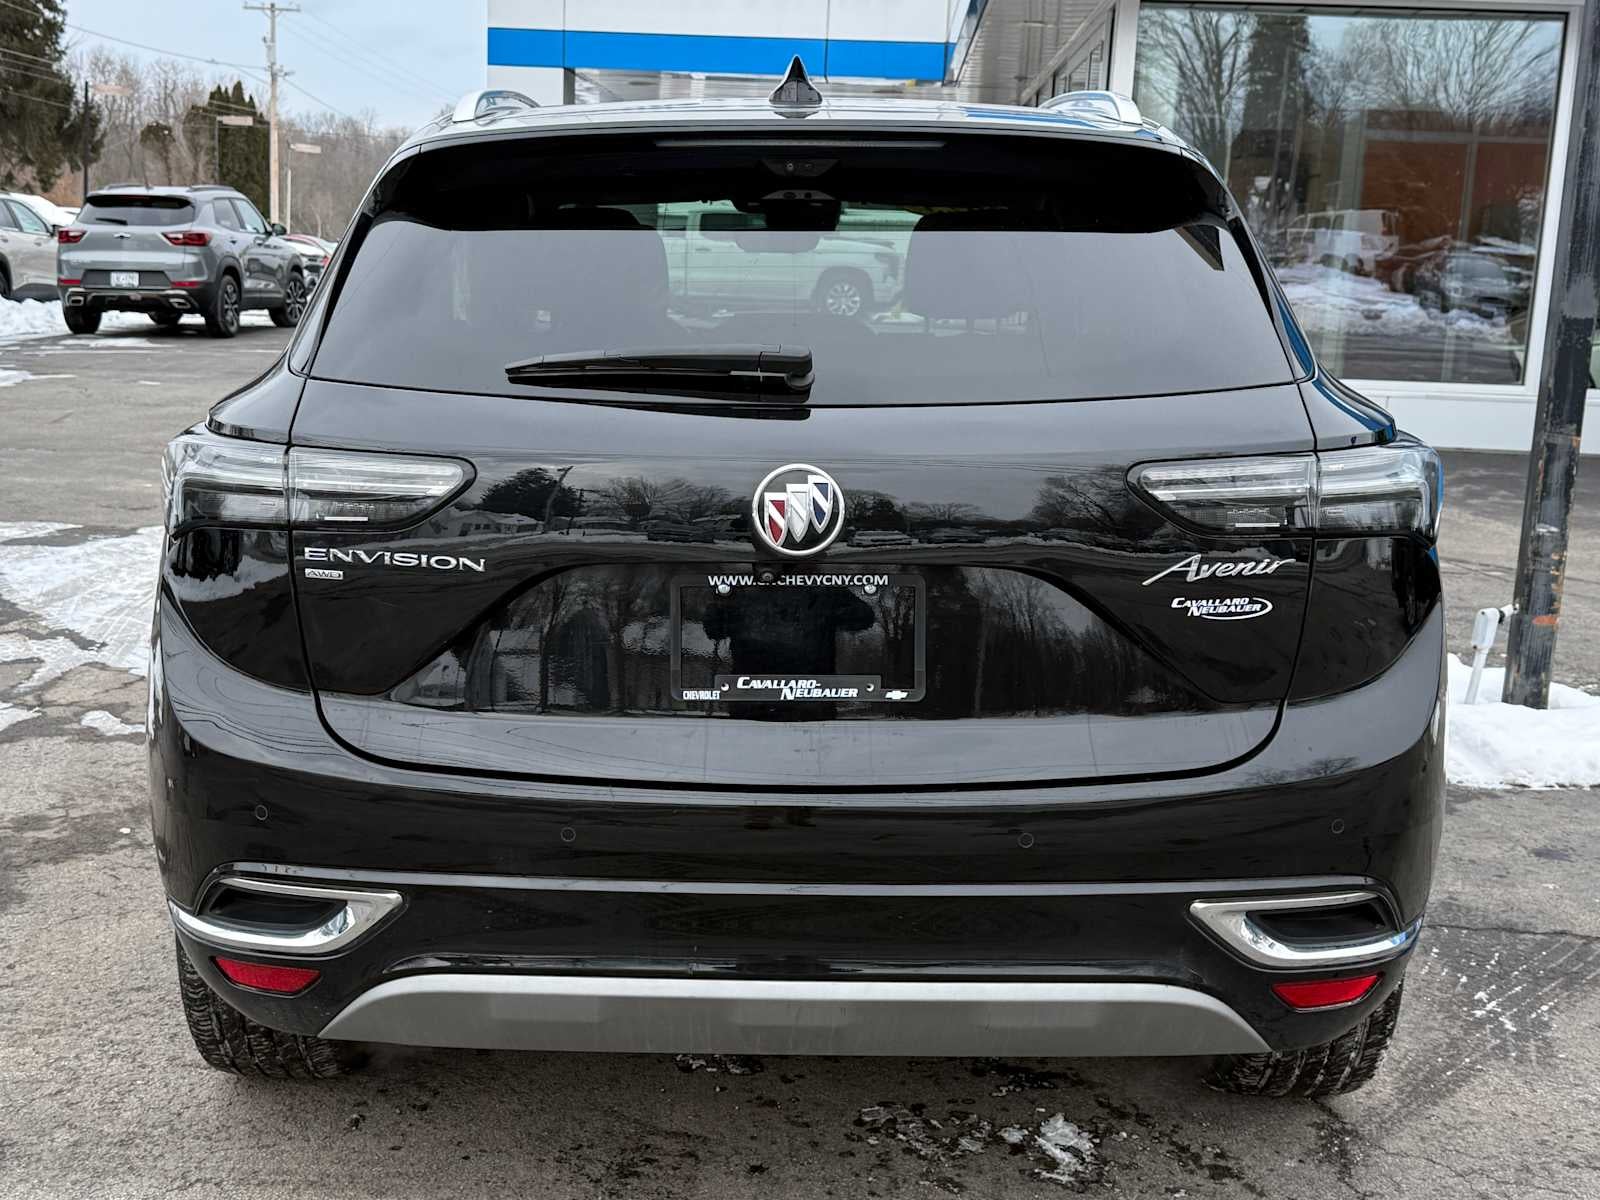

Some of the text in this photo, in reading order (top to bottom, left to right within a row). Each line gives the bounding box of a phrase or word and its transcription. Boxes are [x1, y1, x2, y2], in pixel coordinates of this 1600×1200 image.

[304, 547, 486, 572] ENVISION
[306, 569, 342, 579] AWD
[1142, 554, 1296, 586] Avenir
[708, 574, 888, 586] WWW.CHEVYCNY.COM
[1187, 604, 1262, 617] NEUBAUER
[683, 690, 720, 700] CHEVROLET
[780, 687, 858, 700] NEUBAUER
